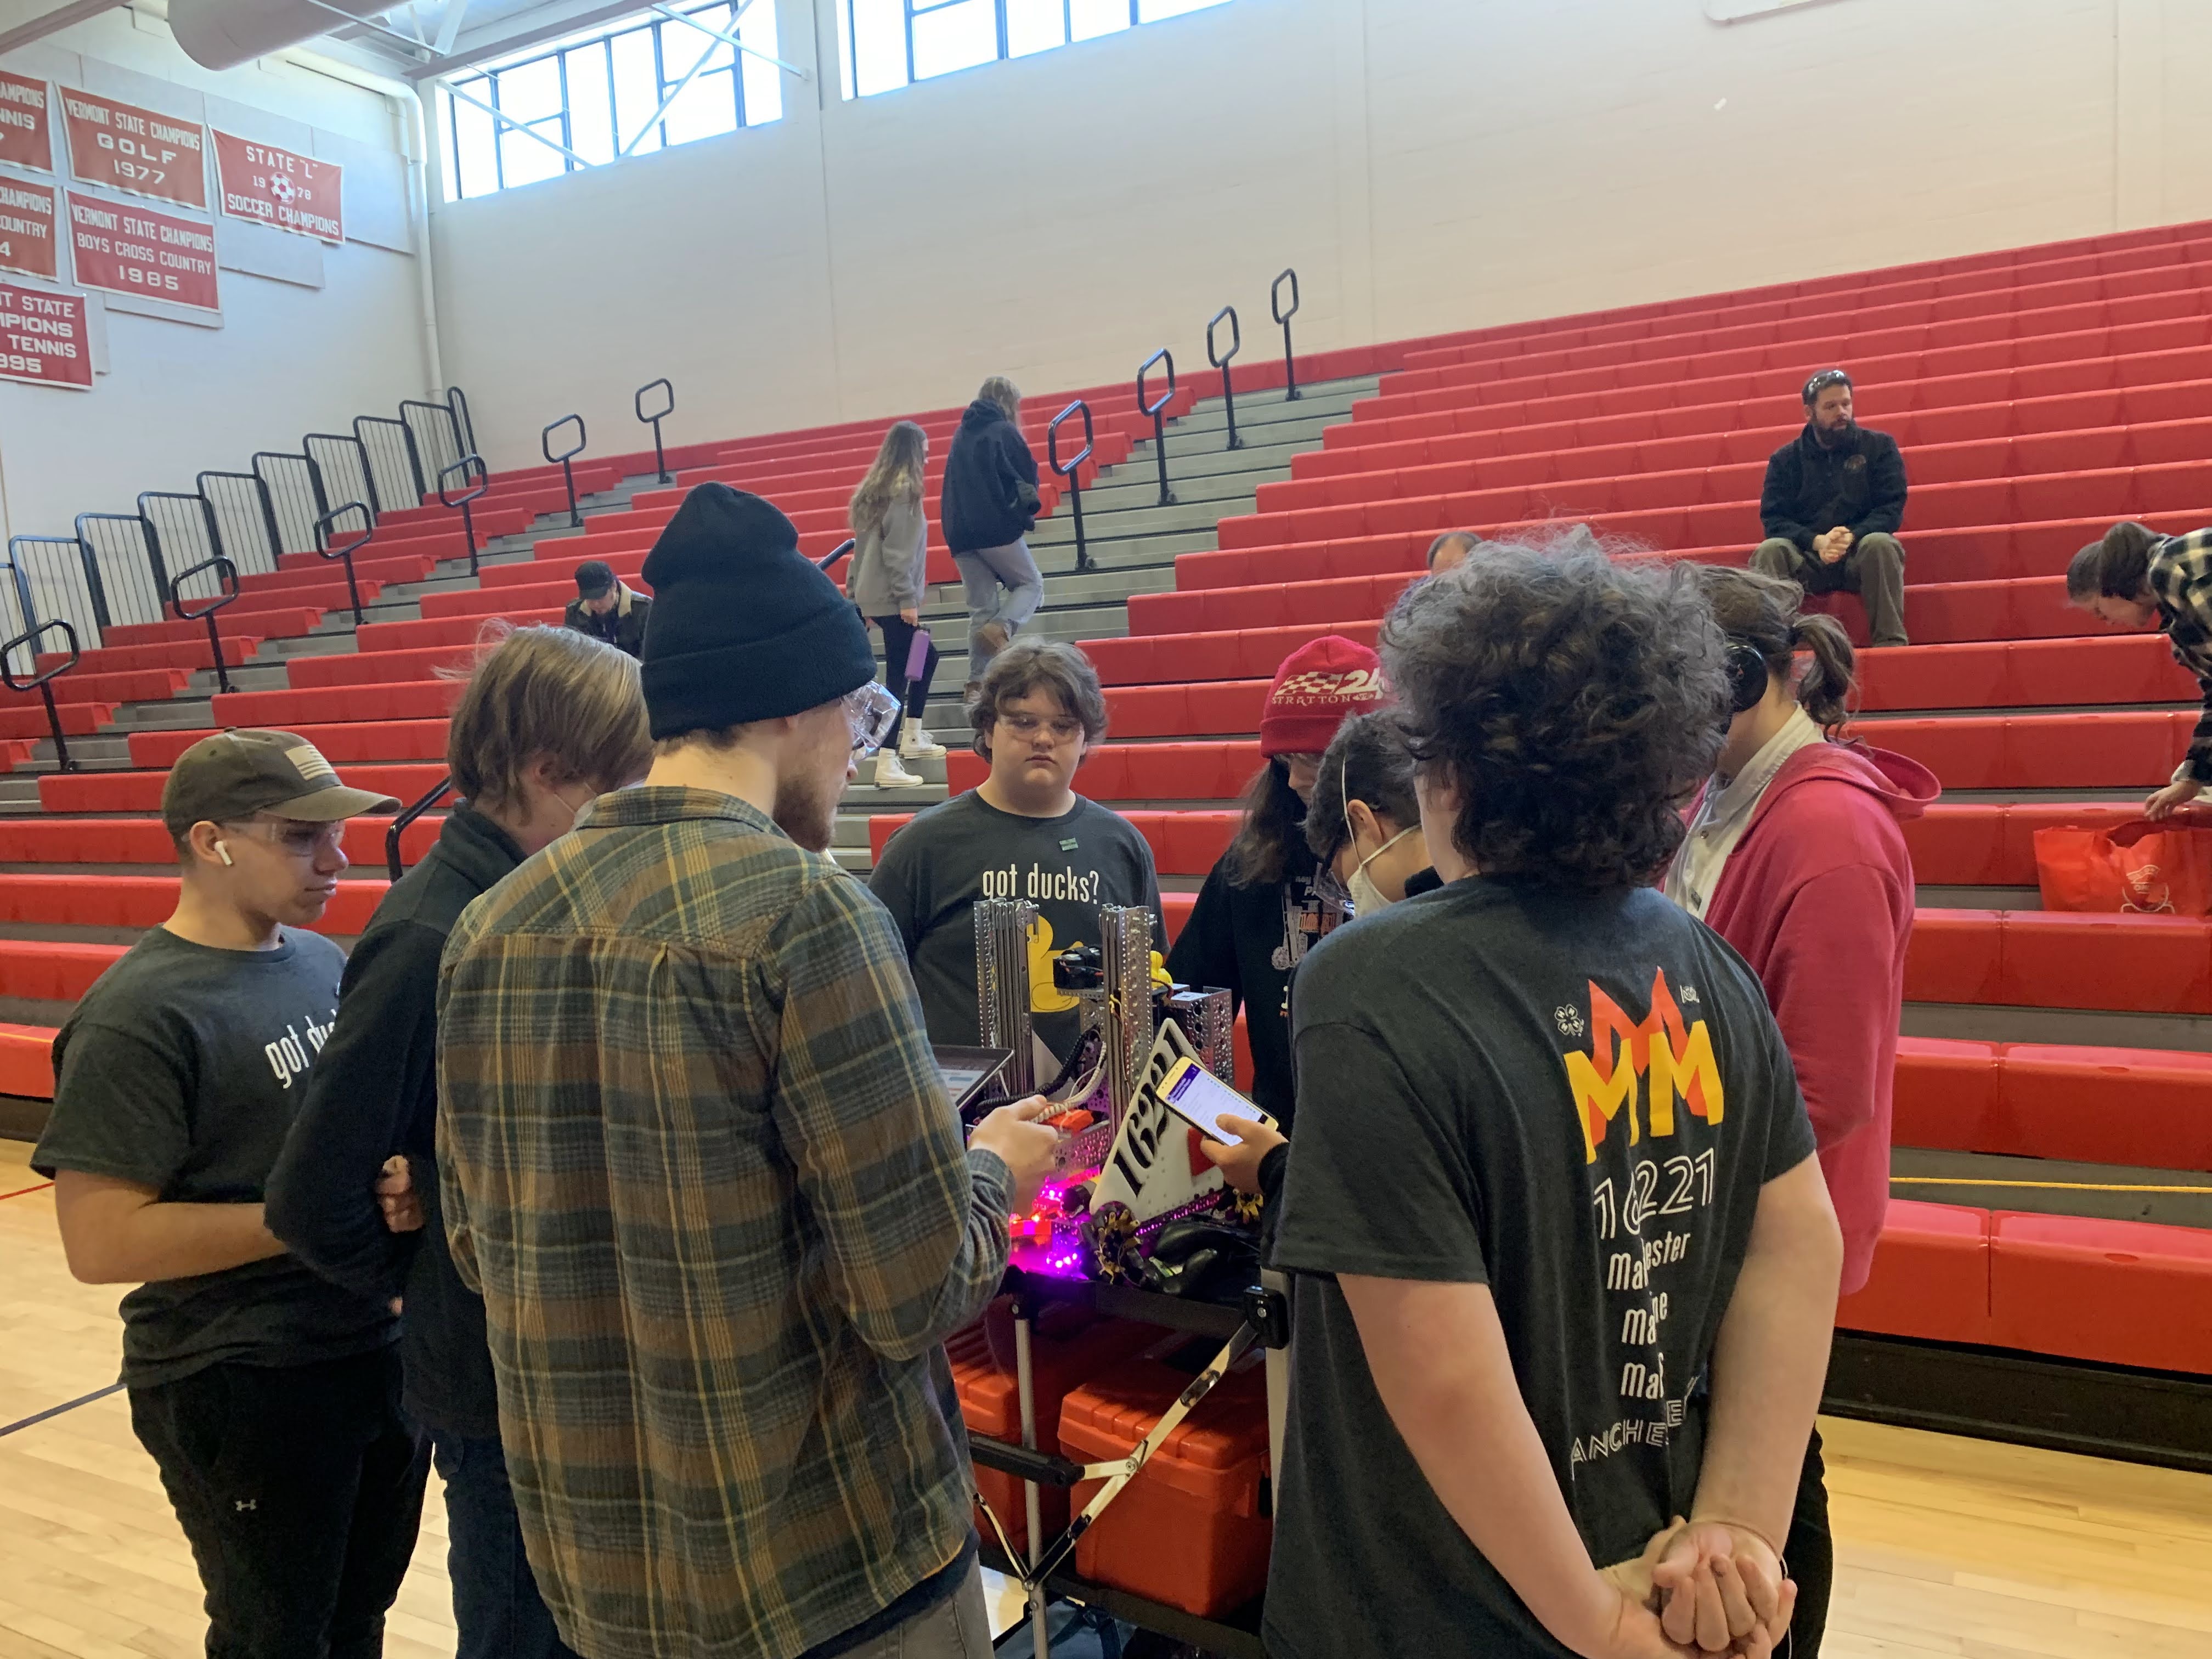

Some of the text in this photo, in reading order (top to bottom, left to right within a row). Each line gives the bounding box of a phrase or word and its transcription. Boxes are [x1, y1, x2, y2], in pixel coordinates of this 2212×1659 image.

[66, 97, 200, 151] VERMONT STATE CHAMPIONS
[97, 132, 176, 163] GOLF
[246, 146, 294, 173] STATE
[114, 159, 165, 184] 1977
[252, 176, 266, 189] 19
[71, 204, 213, 252] VERMONT STATE CHAMPIONS
[228, 193, 339, 235] SOCCER CHAMPIONS
[77, 233, 211, 275] BOYS CROSS COUNTRY
[119, 266, 178, 290] 1985
[22, 296, 75, 318] STATE
[7, 334, 76, 359] TENNIS
[1272, 694, 1350, 706] STRATTON
[983, 862, 1099, 905] got ducks?
[265, 1025, 309, 1088] got
